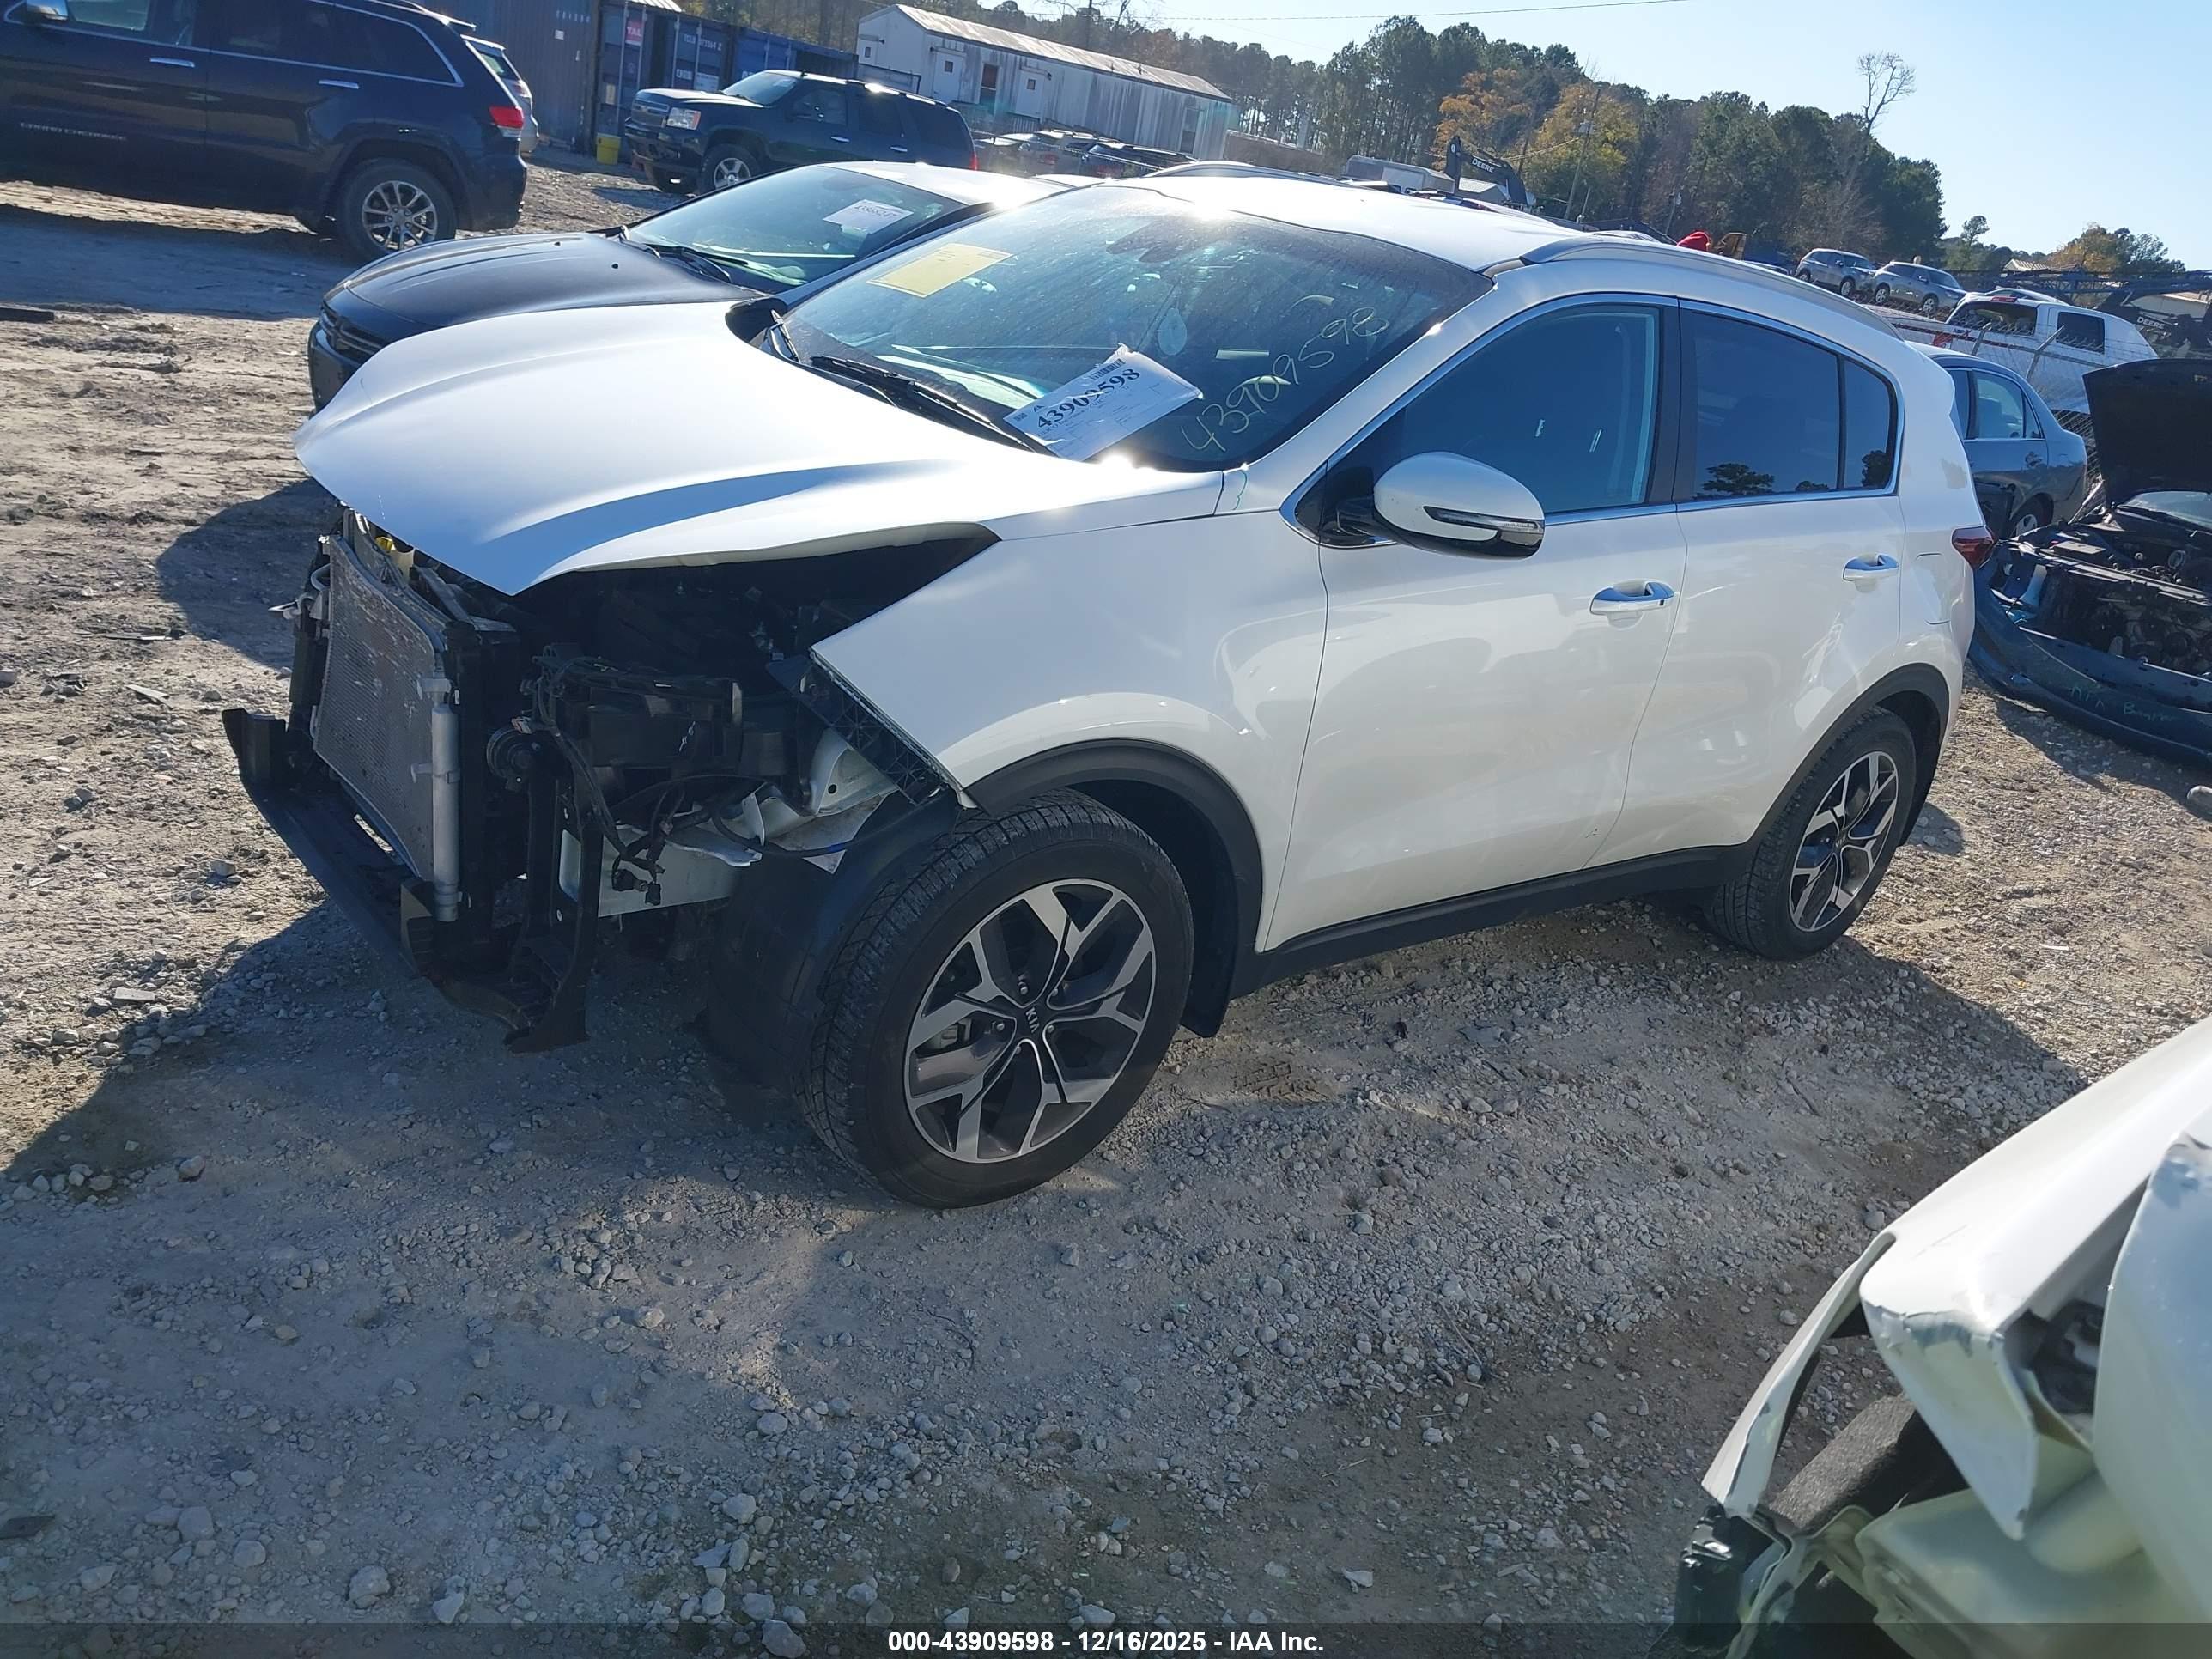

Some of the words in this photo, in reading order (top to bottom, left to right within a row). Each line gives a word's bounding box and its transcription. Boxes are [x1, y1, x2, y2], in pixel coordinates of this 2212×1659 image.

[1471, 158, 1495, 173] DEERE
[2136, 316, 2166, 330] DEERE
[1181, 307, 1390, 452] 43909598
[1038, 368, 1140, 428] 43909598
[1025, 1006, 1040, 1034] KIA
